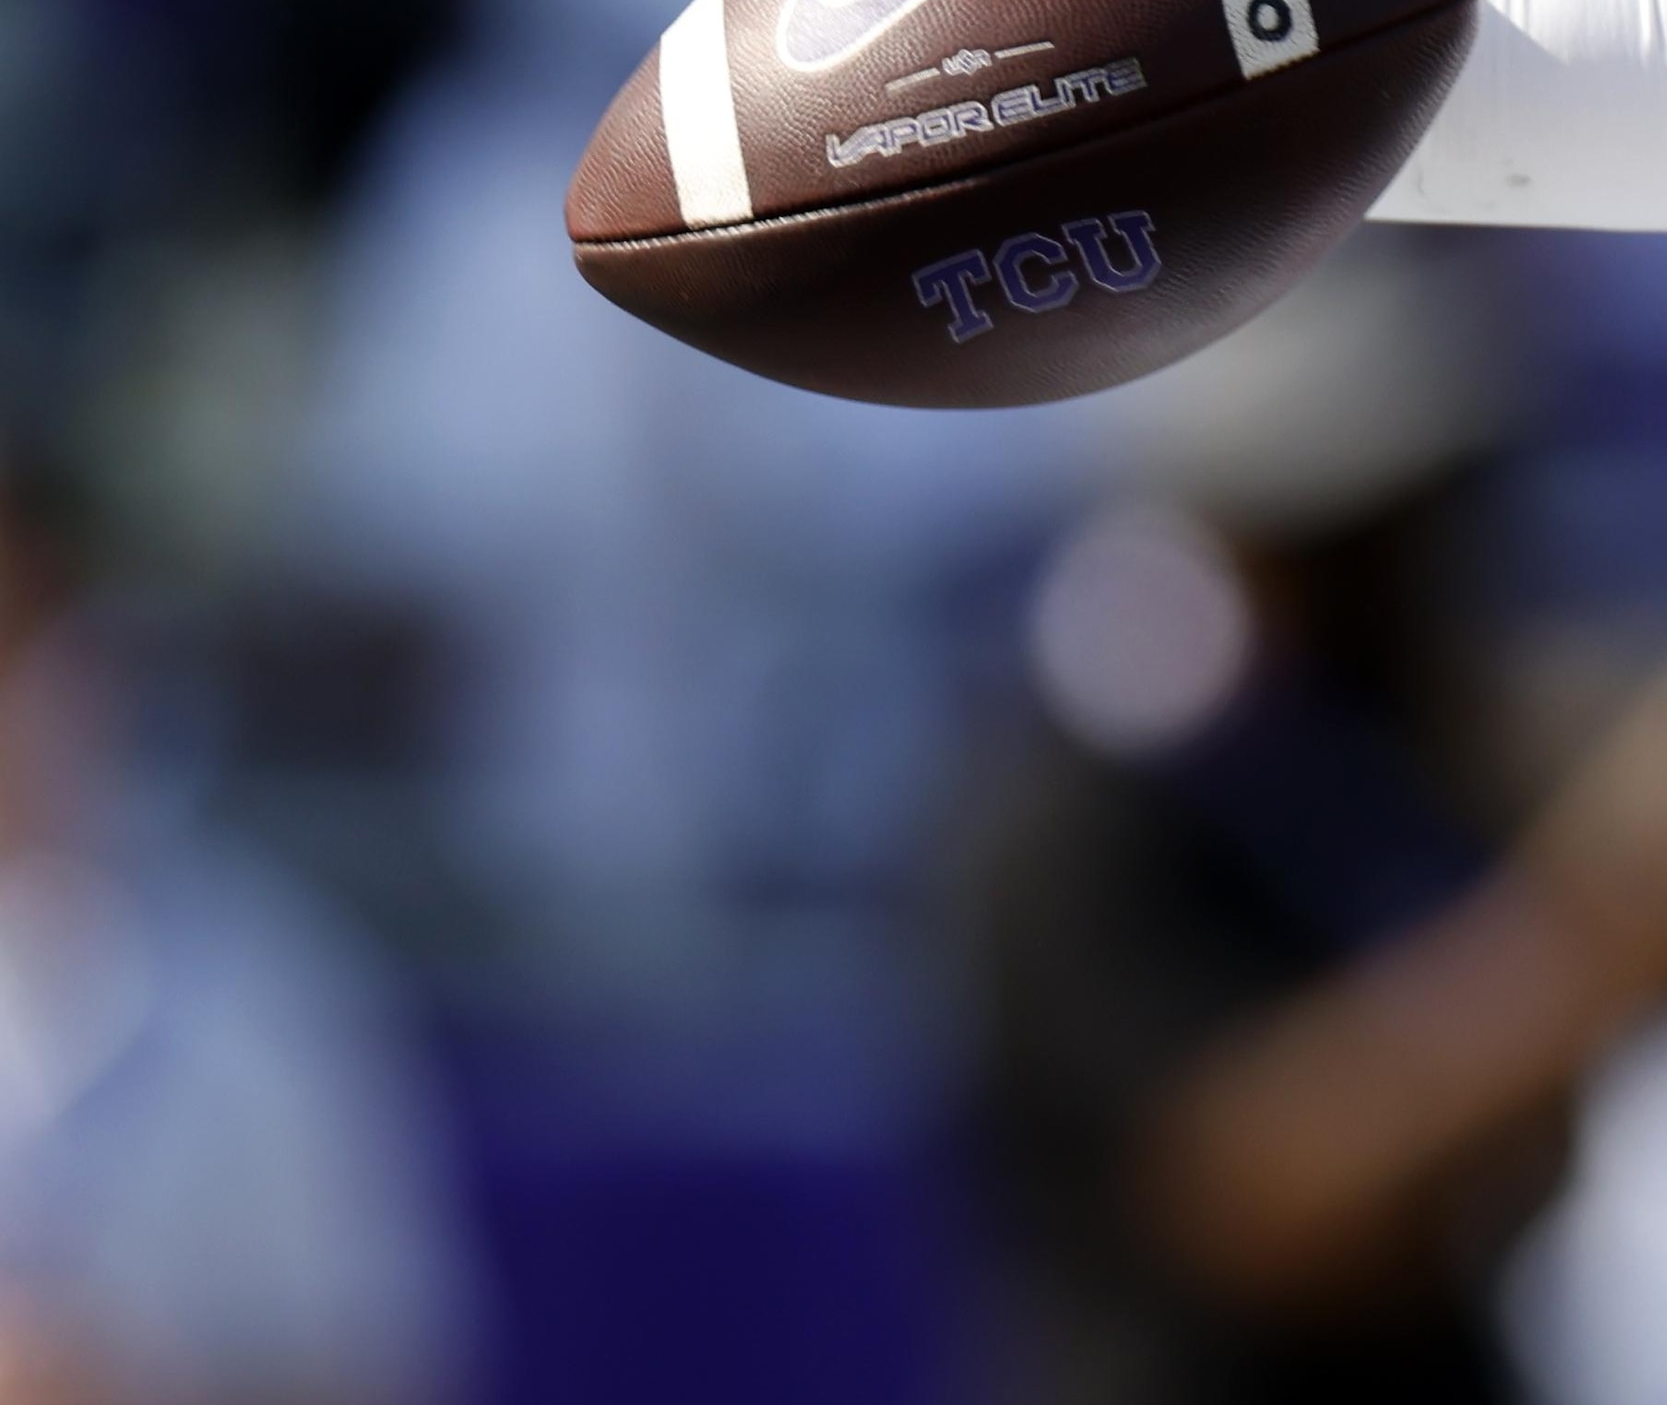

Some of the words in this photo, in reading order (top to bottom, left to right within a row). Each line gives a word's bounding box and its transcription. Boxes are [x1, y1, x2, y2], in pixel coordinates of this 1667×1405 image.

[825, 100, 995, 168] VAPOR
[990, 57, 1149, 127] ELITE
[911, 209, 1162, 344] TCU
